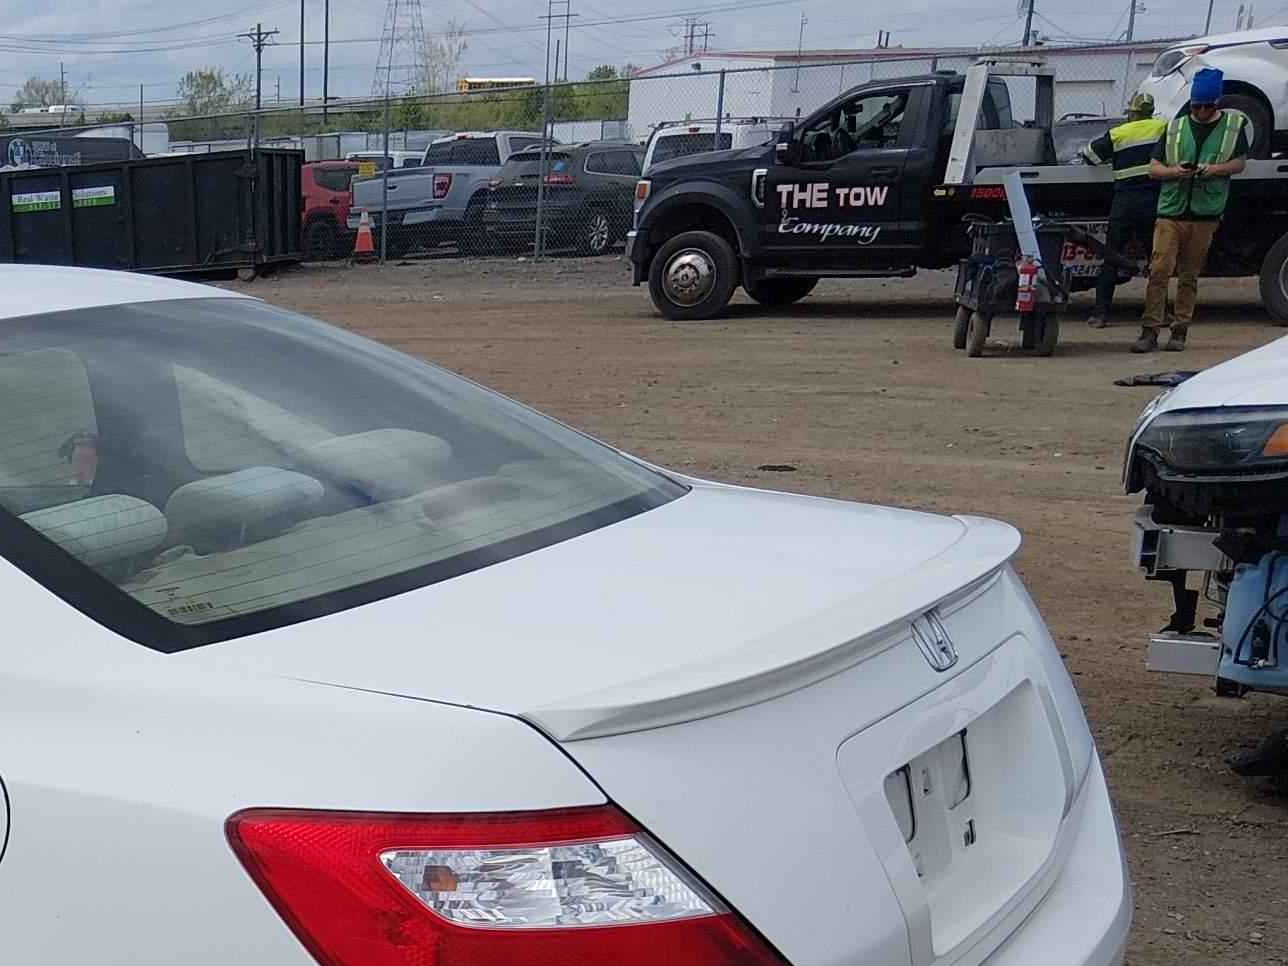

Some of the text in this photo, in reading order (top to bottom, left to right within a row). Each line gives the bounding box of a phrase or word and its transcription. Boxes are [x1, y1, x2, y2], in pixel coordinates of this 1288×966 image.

[776, 183, 829, 208] THE
[835, 186, 888, 207] TOW
[777, 217, 881, 245] Company
